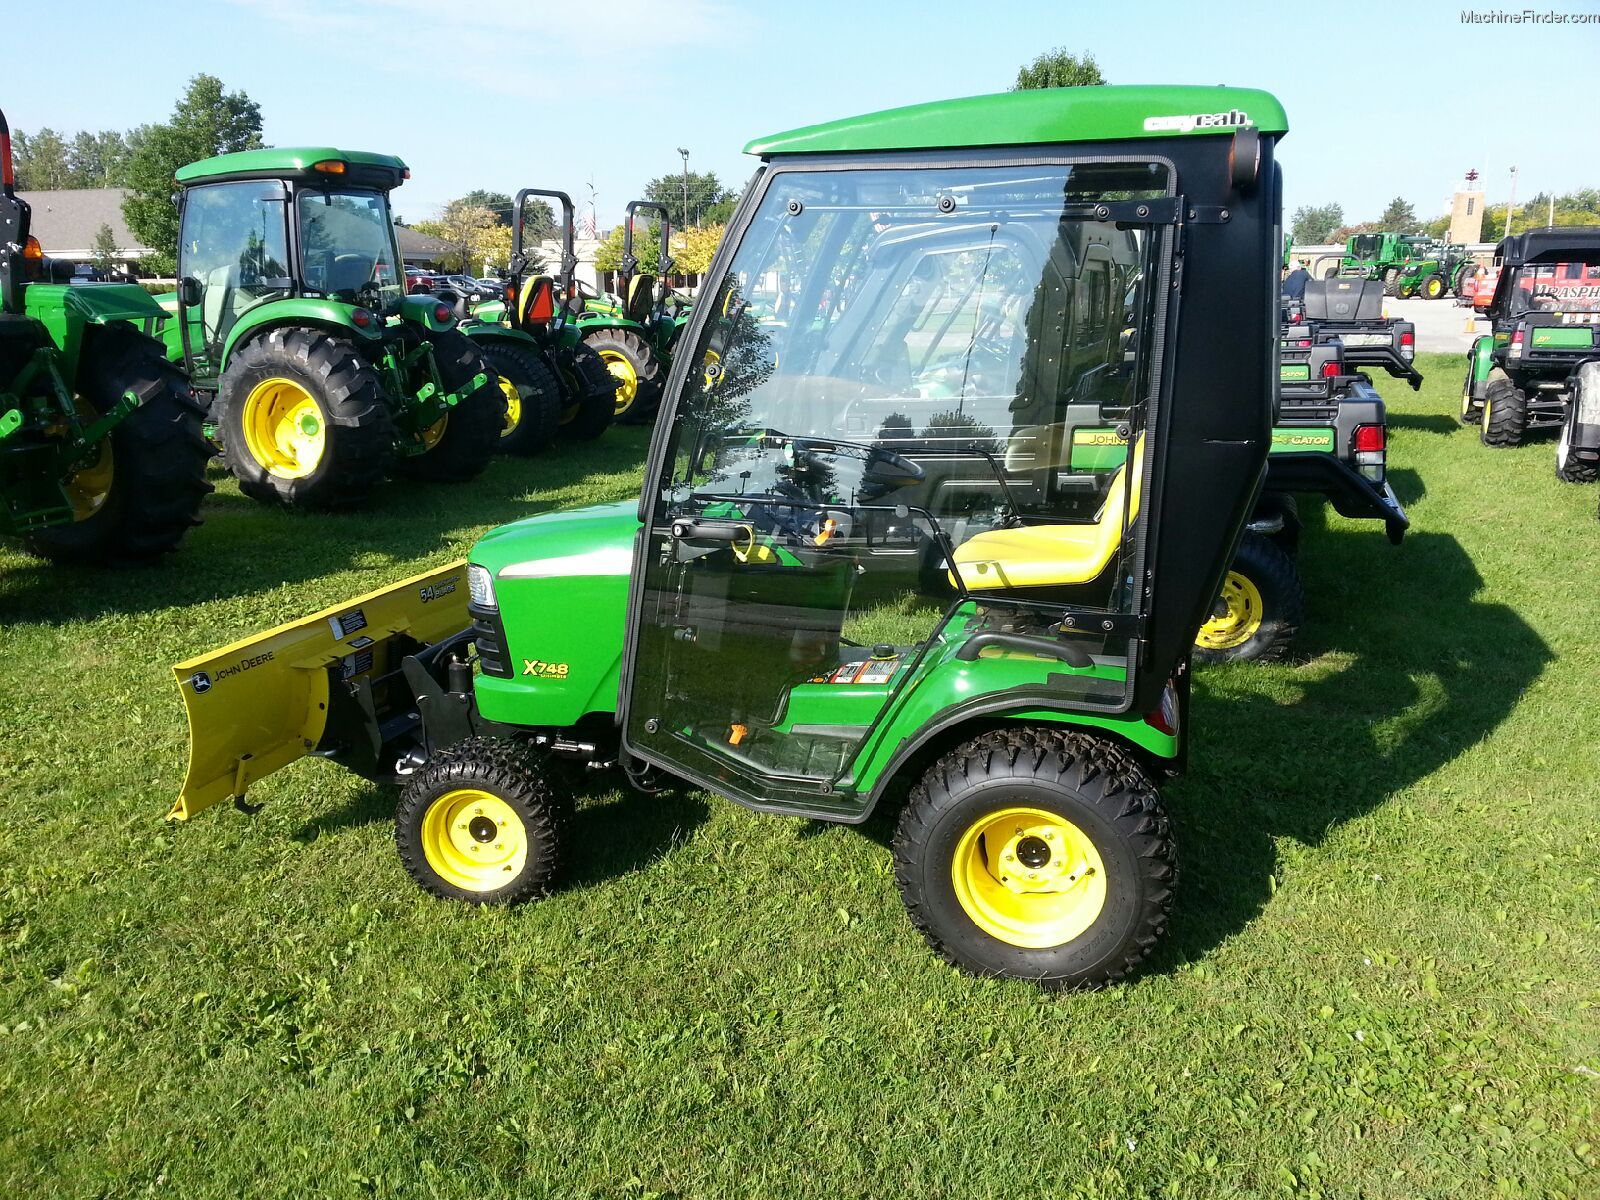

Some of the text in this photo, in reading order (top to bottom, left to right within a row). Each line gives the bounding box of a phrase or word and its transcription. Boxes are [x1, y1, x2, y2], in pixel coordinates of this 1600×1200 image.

[1291, 435, 1329, 445] GATOR
[420, 585, 434, 603] 54
[215, 651, 275, 682] JOHN DEERE
[522, 658, 569, 677] X748
